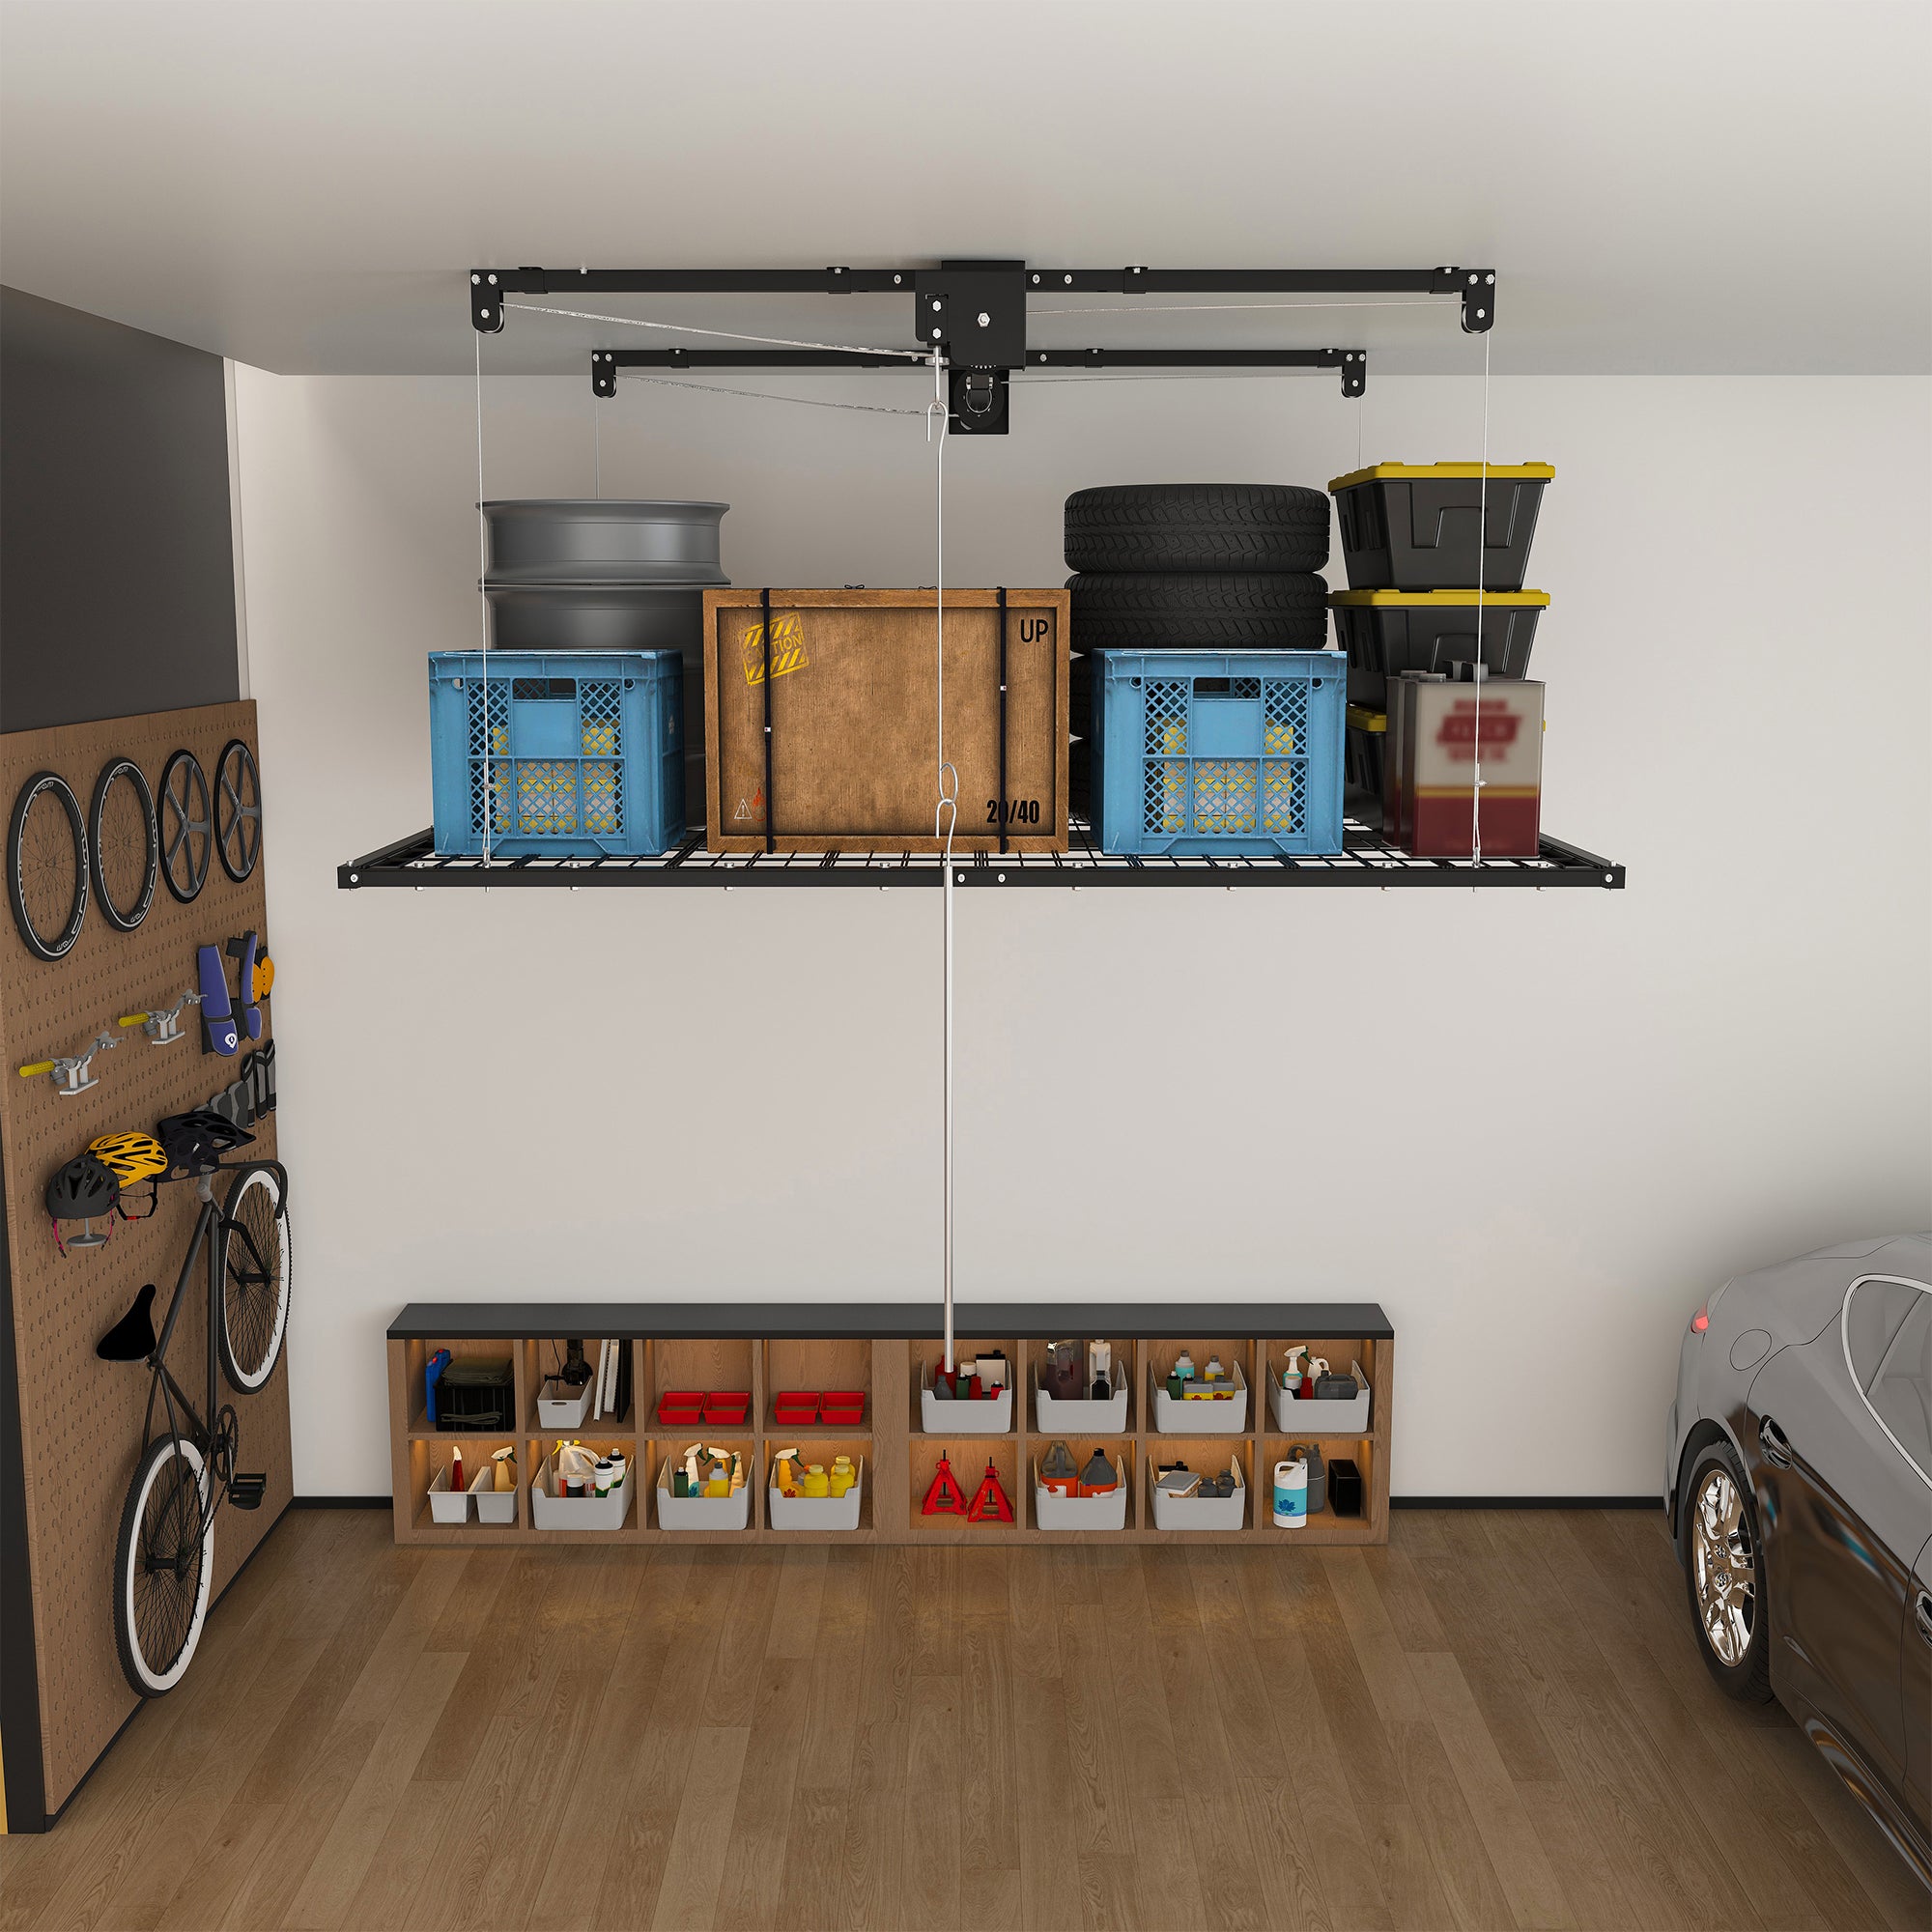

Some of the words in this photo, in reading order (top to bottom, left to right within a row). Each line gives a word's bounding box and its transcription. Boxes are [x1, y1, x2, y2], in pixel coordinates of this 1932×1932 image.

[1021, 619, 1048, 642] UP
[746, 633, 803, 665] CATION
[987, 800, 1039, 823] 20/40
